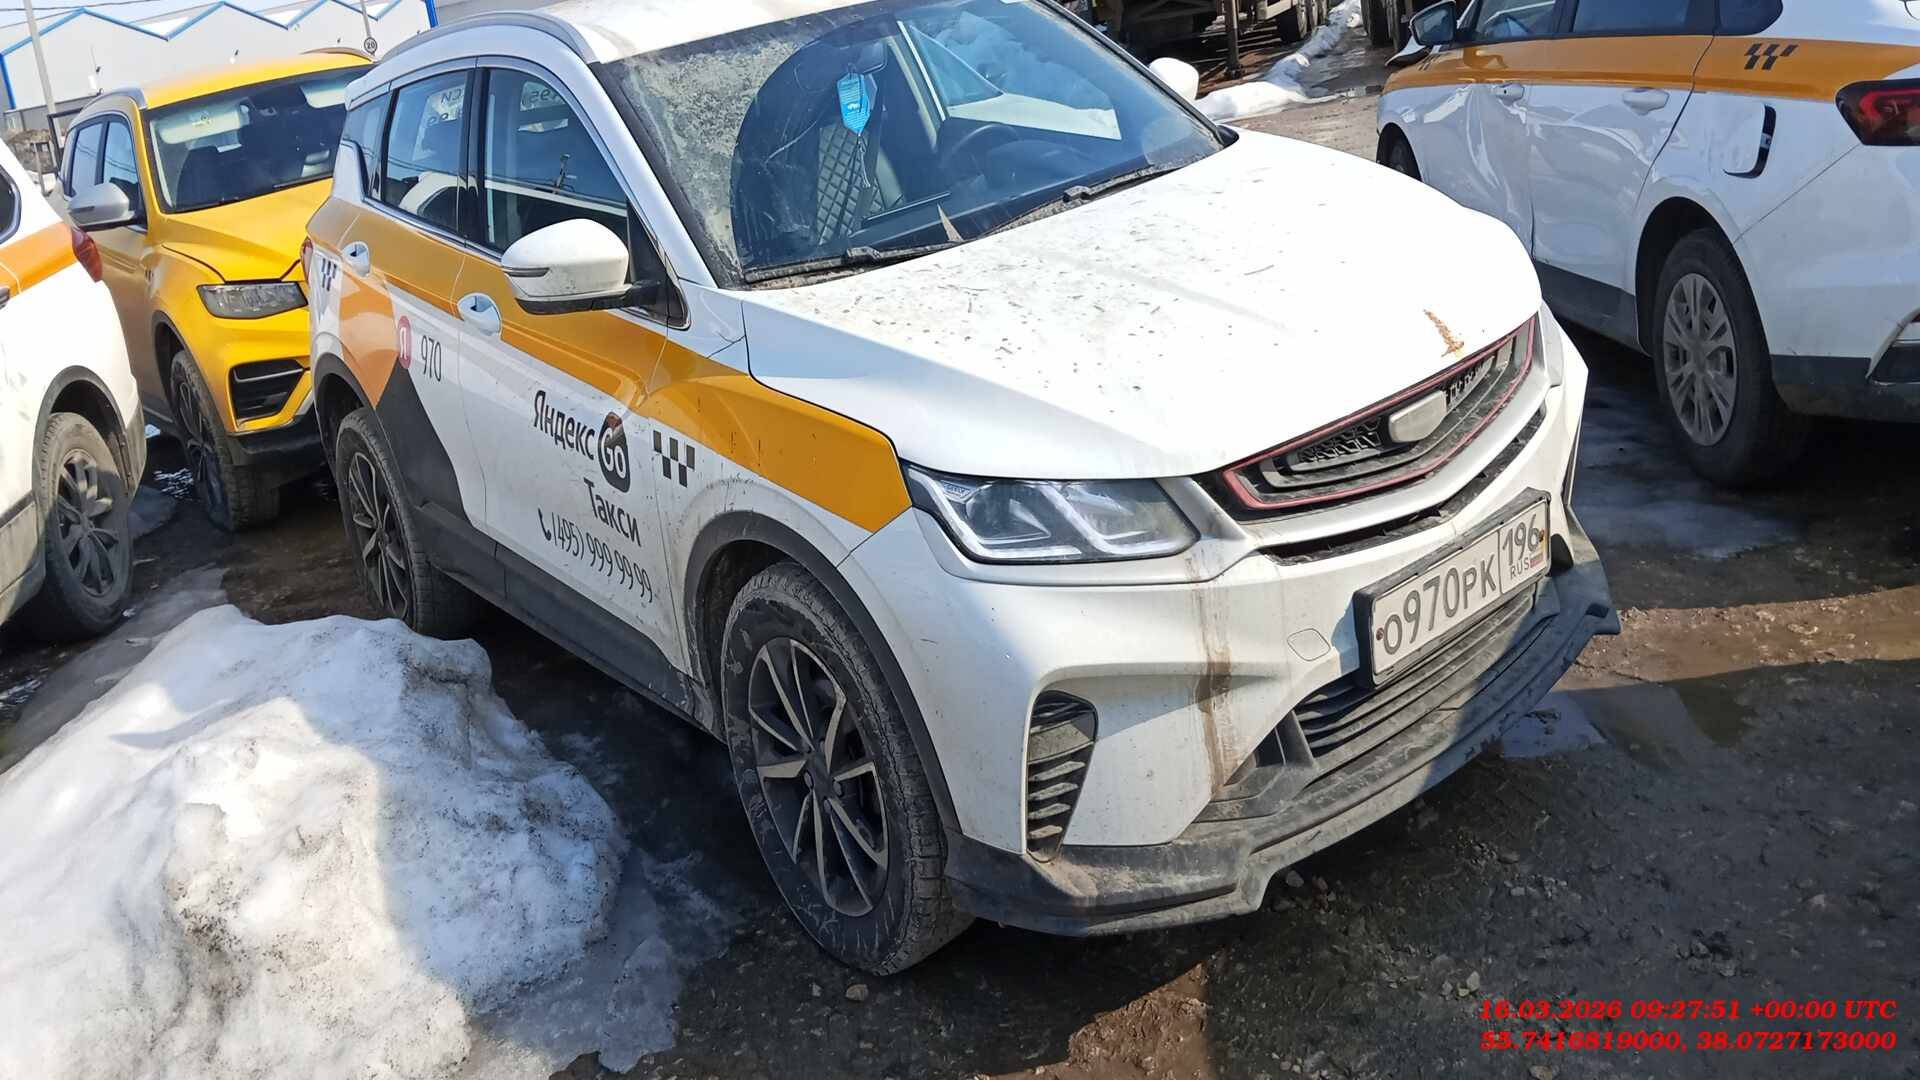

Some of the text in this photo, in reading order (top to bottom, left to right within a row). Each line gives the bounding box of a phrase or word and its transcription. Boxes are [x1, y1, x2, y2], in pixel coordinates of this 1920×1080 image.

[421, 334, 441, 382] 970
[533, 389, 627, 479] Яндекс Go
[583, 477, 641, 548] Такси
[1502, 513, 1540, 567] 196
[551, 511, 653, 603] (495) 999 99 99
[1510, 556, 1530, 580] RUS
